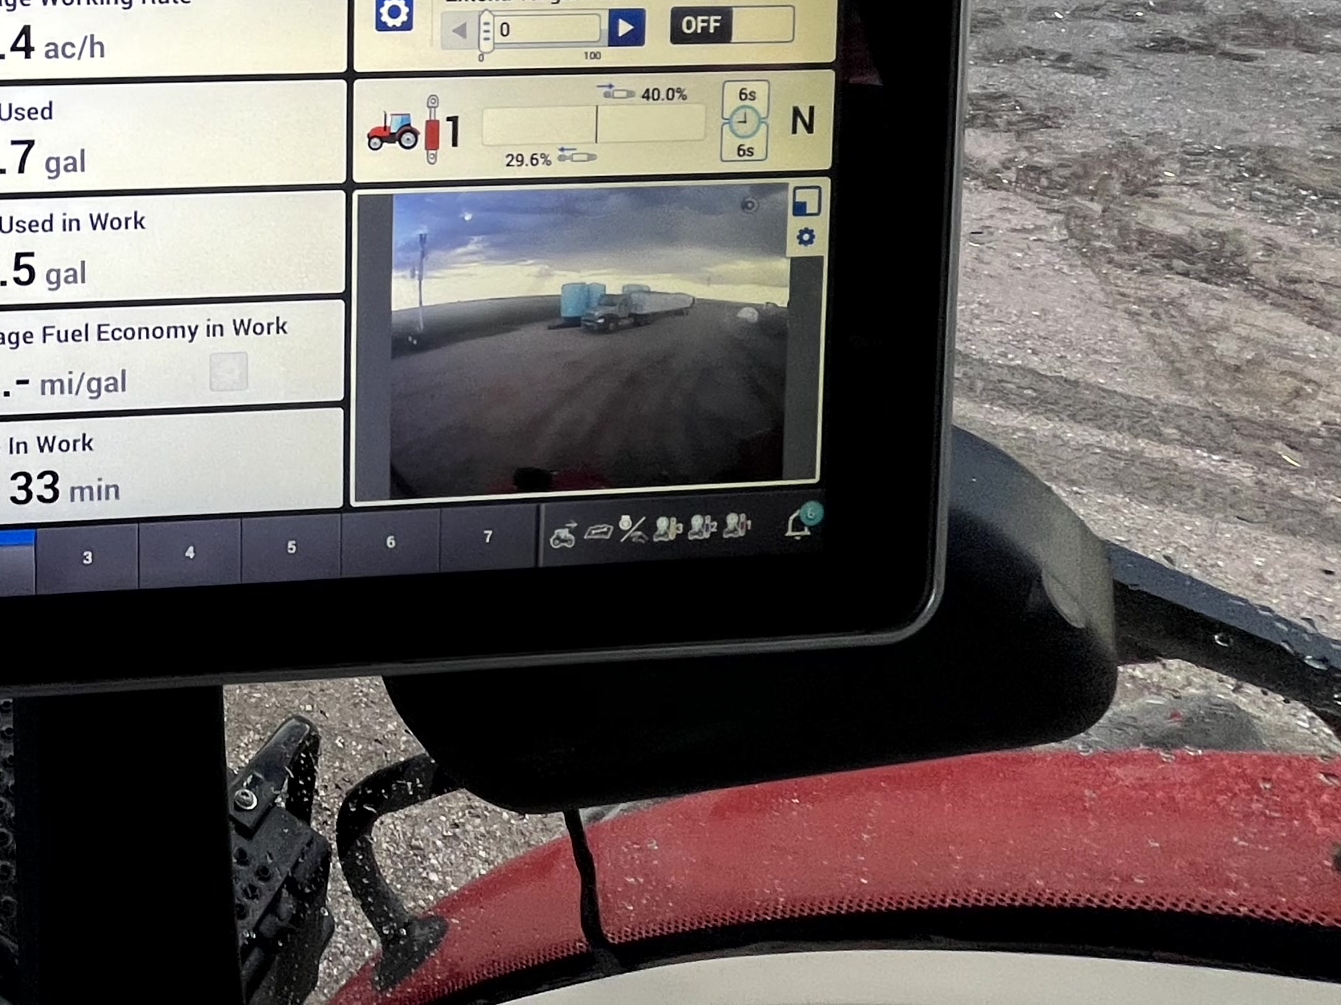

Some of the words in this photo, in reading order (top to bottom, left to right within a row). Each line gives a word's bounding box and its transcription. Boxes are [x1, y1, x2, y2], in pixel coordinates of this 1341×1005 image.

[499, 22, 511, 38] 0
[682, 16, 722, 33] OFF
[44, 35, 105, 62] ac/h
[584, 51, 602, 60] 100
[641, 86, 688, 103] 40.0%
[739, 87, 757, 102] 6s
[791, 105, 815, 135] N
[446, 115, 459, 148] 1
[737, 143, 754, 158] 6s
[45, 149, 85, 180] gal
[505, 151, 552, 168] 29.6%
[0, 215, 53, 234] Used
[62, 214, 81, 232] in
[89, 211, 146, 231] Work
[46, 261, 86, 291] gal
[42, 325, 90, 344] Fuel
[97, 321, 198, 342] Economy
[206, 318, 224, 338] in
[232, 317, 288, 336] Work
[40, 370, 127, 400] mi/gal
[9, 437, 28, 455] In
[36, 433, 94, 453] Work
[9, 470, 61, 505] 33
[70, 481, 120, 502] min
[676, 523, 683, 534] 3
[711, 521, 718, 532] 2
[746, 519, 752, 530] 1
[386, 535, 395, 549] 6
[483, 530, 493, 543] 7
[185, 546, 195, 560] 4
[287, 540, 296, 555] 5
[83, 551, 93, 565] 3
